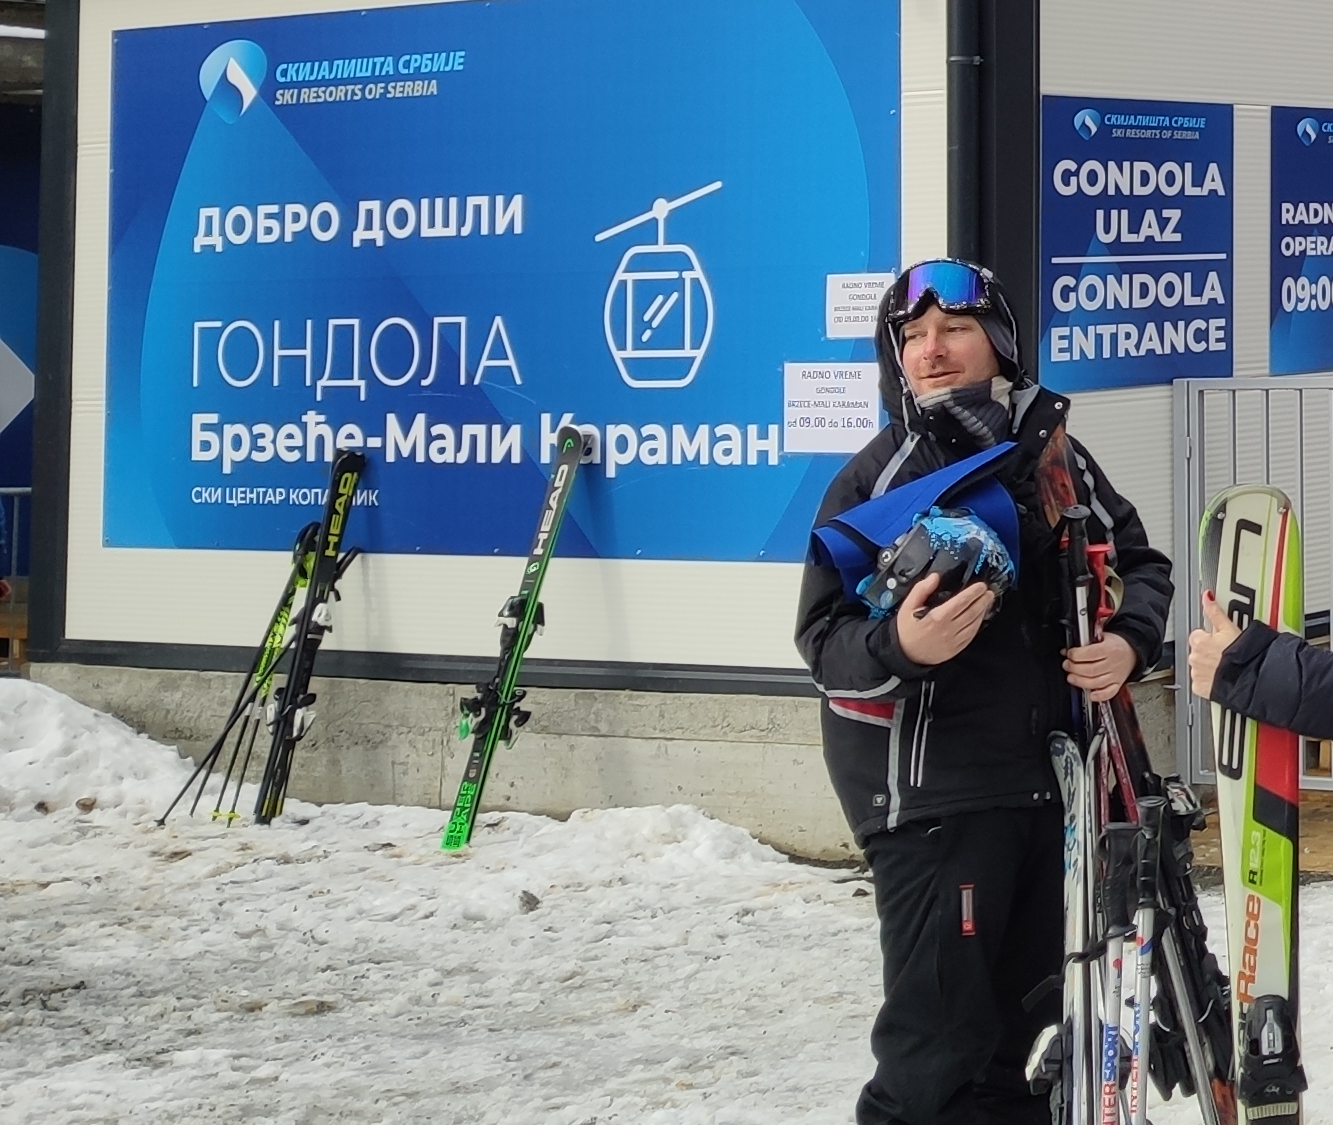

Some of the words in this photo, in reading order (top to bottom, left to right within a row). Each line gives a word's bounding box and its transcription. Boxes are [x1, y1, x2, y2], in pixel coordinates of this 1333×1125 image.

[275, 56, 394, 82] СКИЈАЛИШТА
[397, 51, 466, 74] СРБИЈЕ
[275, 88, 298, 105] SKI
[300, 85, 362, 104] RESORTS
[365, 83, 385, 99] OF
[387, 80, 438, 97] SERBIA
[1104, 114, 1170, 127] СКИЈАЛИШТА
[1171, 117, 1206, 129] СРБИЈЕ
[1112, 128, 1124, 138] SKI
[1126, 129, 1160, 139] RESORTS
[1161, 130, 1173, 138] OF
[1173, 130, 1200, 140] SERBIA
[1053, 159, 1226, 197] GONDOLA
[193, 201, 340, 253] ДОБРО
[352, 194, 524, 248] ДОШЛИ
[1096, 209, 1182, 243] ULAZ
[1052, 271, 1225, 312] GONDOLA
[193, 315, 522, 401] ГОНДОЛА
[1051, 318, 1226, 362] ENTRANCE
[801, 370, 831, 379] RADNO
[832, 370, 862, 379] VREME
[799, 417, 826, 428] 09.00
[828, 419, 839, 428] do
[841, 417, 874, 428] 16.00h
[191, 410, 521, 475] Брзеће-Мали
[191, 486, 222, 505] СКИ
[225, 487, 286, 507] ЦЕНТАР
[324, 472, 358, 557] HEAD
[533, 464, 568, 555] HEAD
[1237, 894, 1261, 1004] Race
